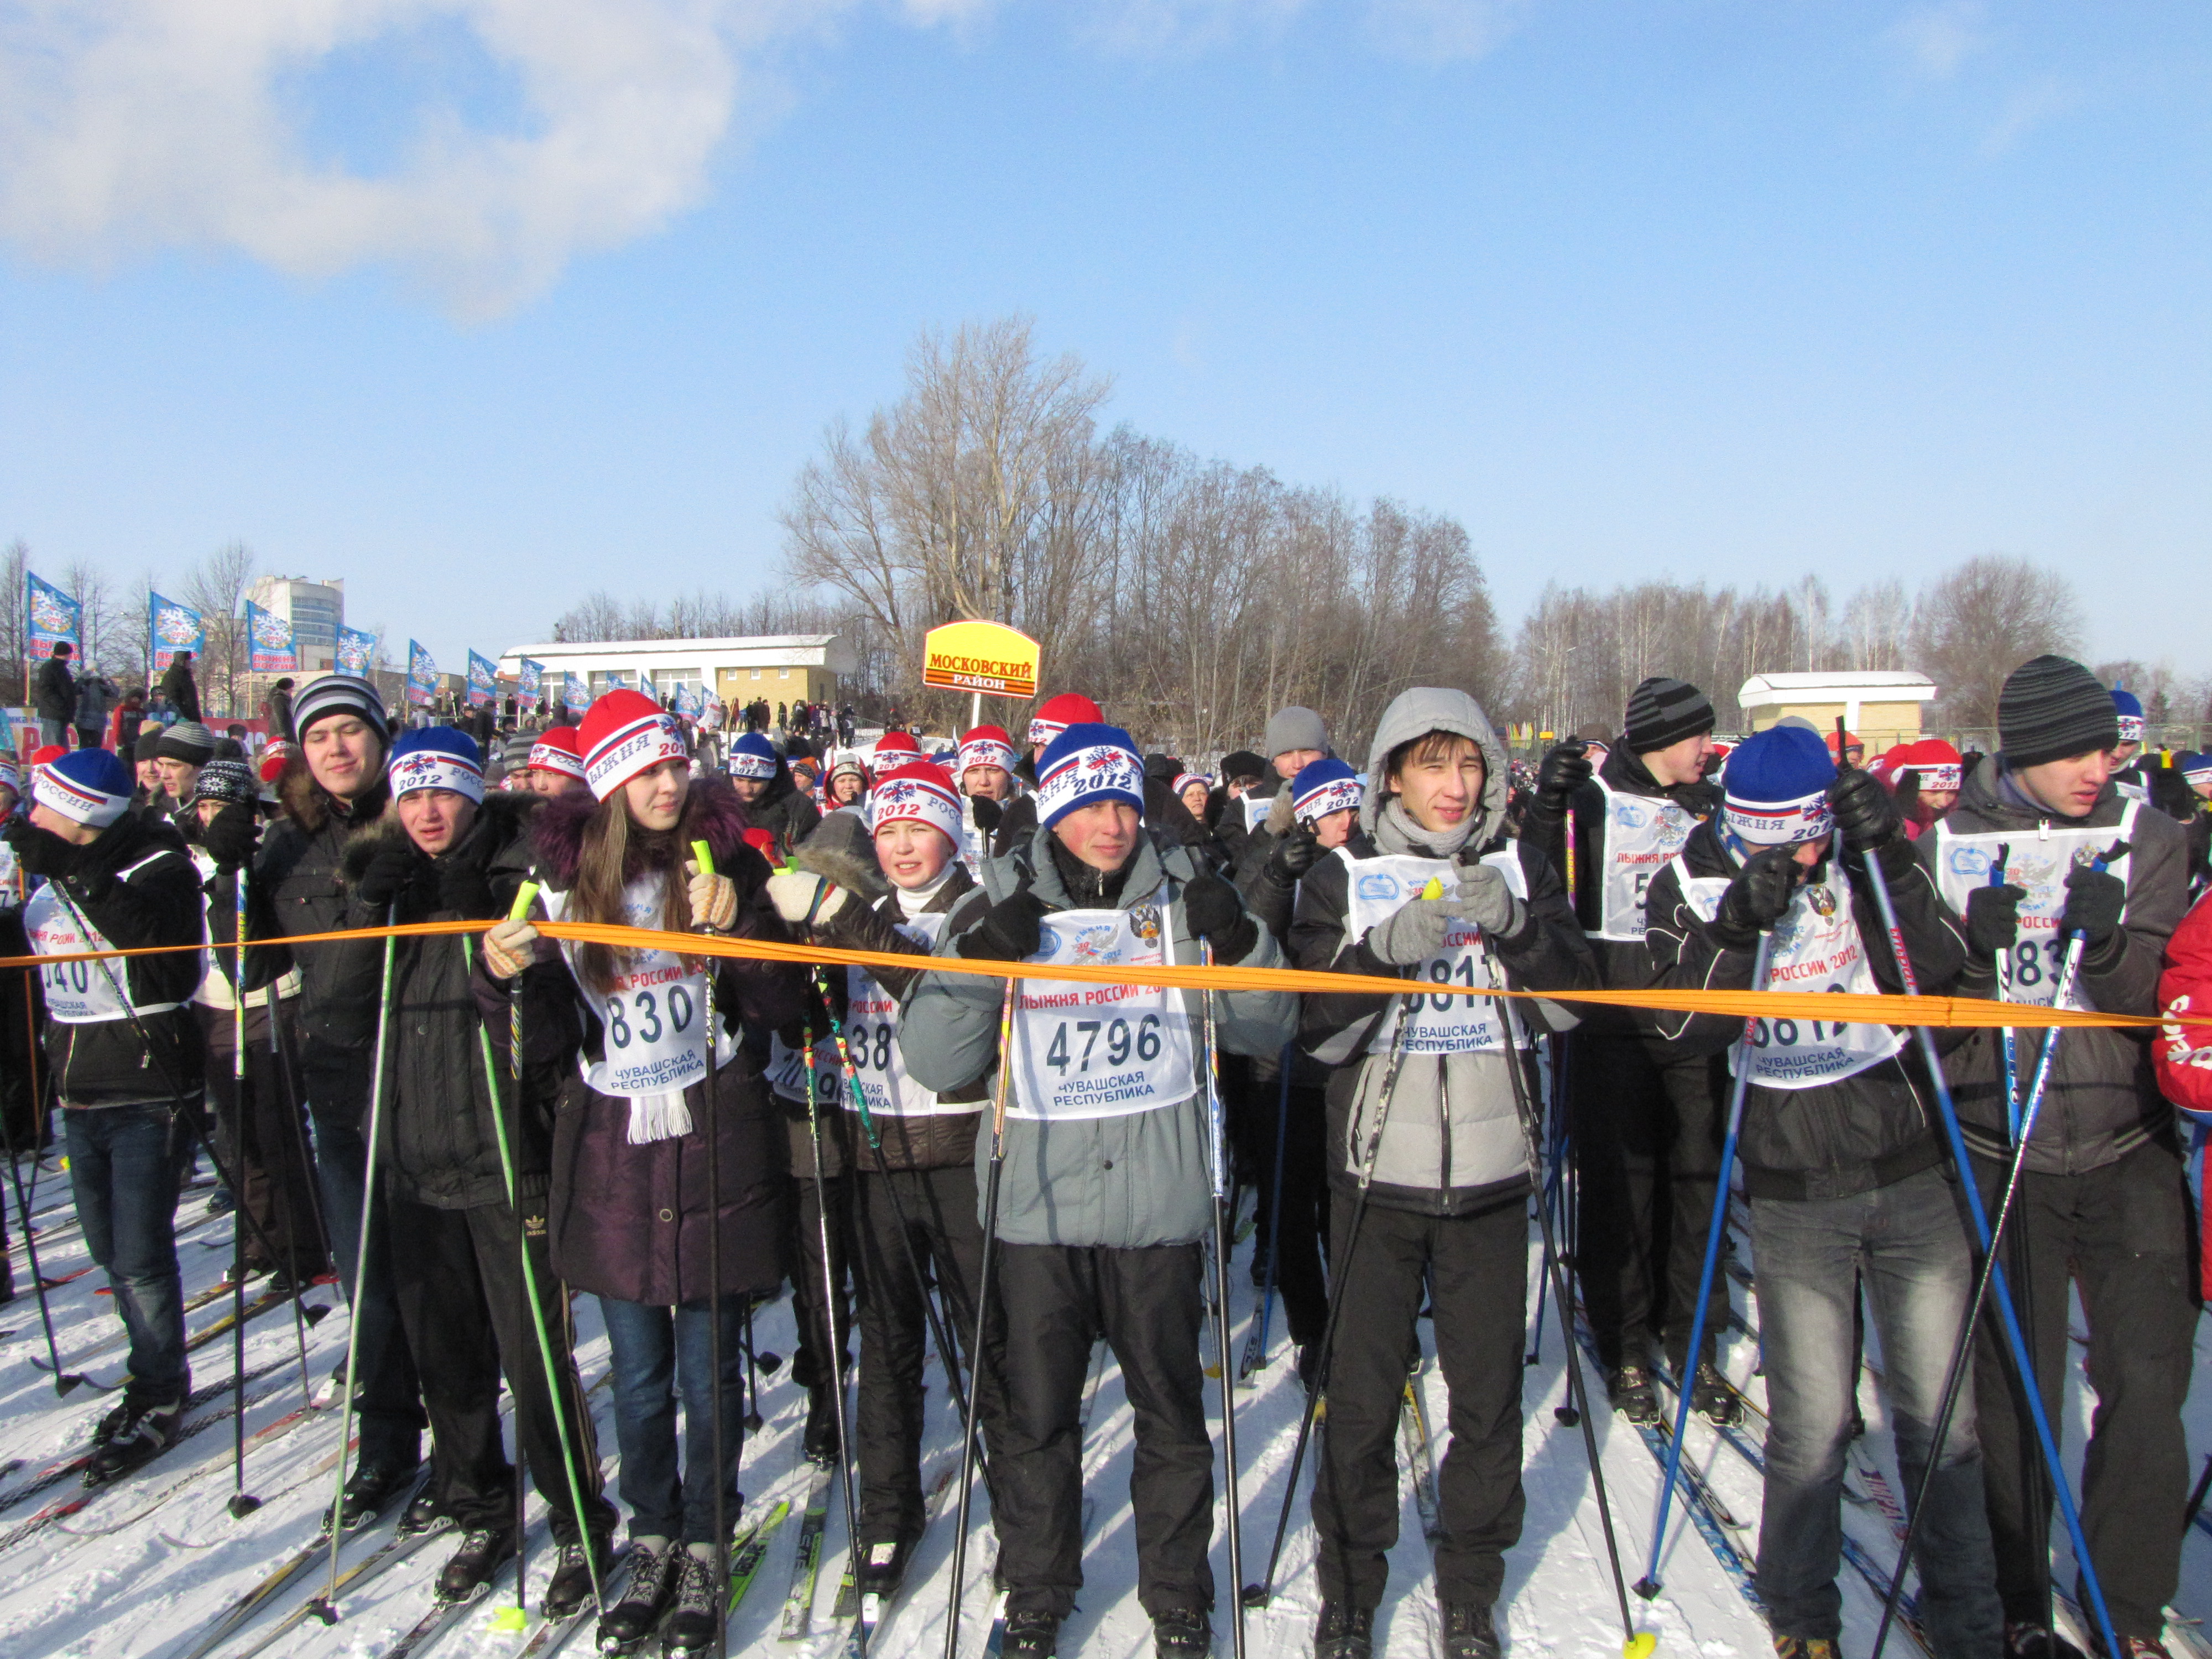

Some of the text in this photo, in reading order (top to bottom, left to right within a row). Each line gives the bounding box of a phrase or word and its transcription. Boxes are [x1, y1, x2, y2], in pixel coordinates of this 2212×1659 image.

[930, 653, 1032, 679] МОСКОВСКИЙ
[953, 674, 1006, 690] РАЙОН
[969, 755, 997, 764] 2012
[733, 766, 758, 776] 2012
[399, 775, 442, 791] 2012
[1073, 774, 1131, 796] 2012
[878, 804, 921, 821] 2012
[1326, 796, 1359, 811] 2012
[1616, 853, 1660, 864] ЛЫЖНЯ
[1102, 948, 1123, 959] 2012
[1770, 945, 1858, 983] РОССИИ 2012
[630, 966, 683, 990] РОССИИ
[1019, 993, 1079, 1010] ЛЫЖНЯ
[1086, 984, 1139, 1006] РОССИИ
[606, 984, 693, 1050] 830
[1046, 1013, 1161, 1077] 4796
[1403, 1035, 1493, 1052] ЕСПУБЛИКА
[615, 1048, 696, 1081] ЧУВАШСКАЯ
[1761, 1047, 1845, 1067] ЧУВАШСКАЯ
[611, 1059, 705, 1090] РЕСПУБЛИКА
[1755, 1058, 1854, 1079] РЕСПУБЛИКА
[1058, 1071, 1145, 1094] ЧУВАШСКАЯ
[1053, 1084, 1155, 1107] РЕСПУБЛИКА
